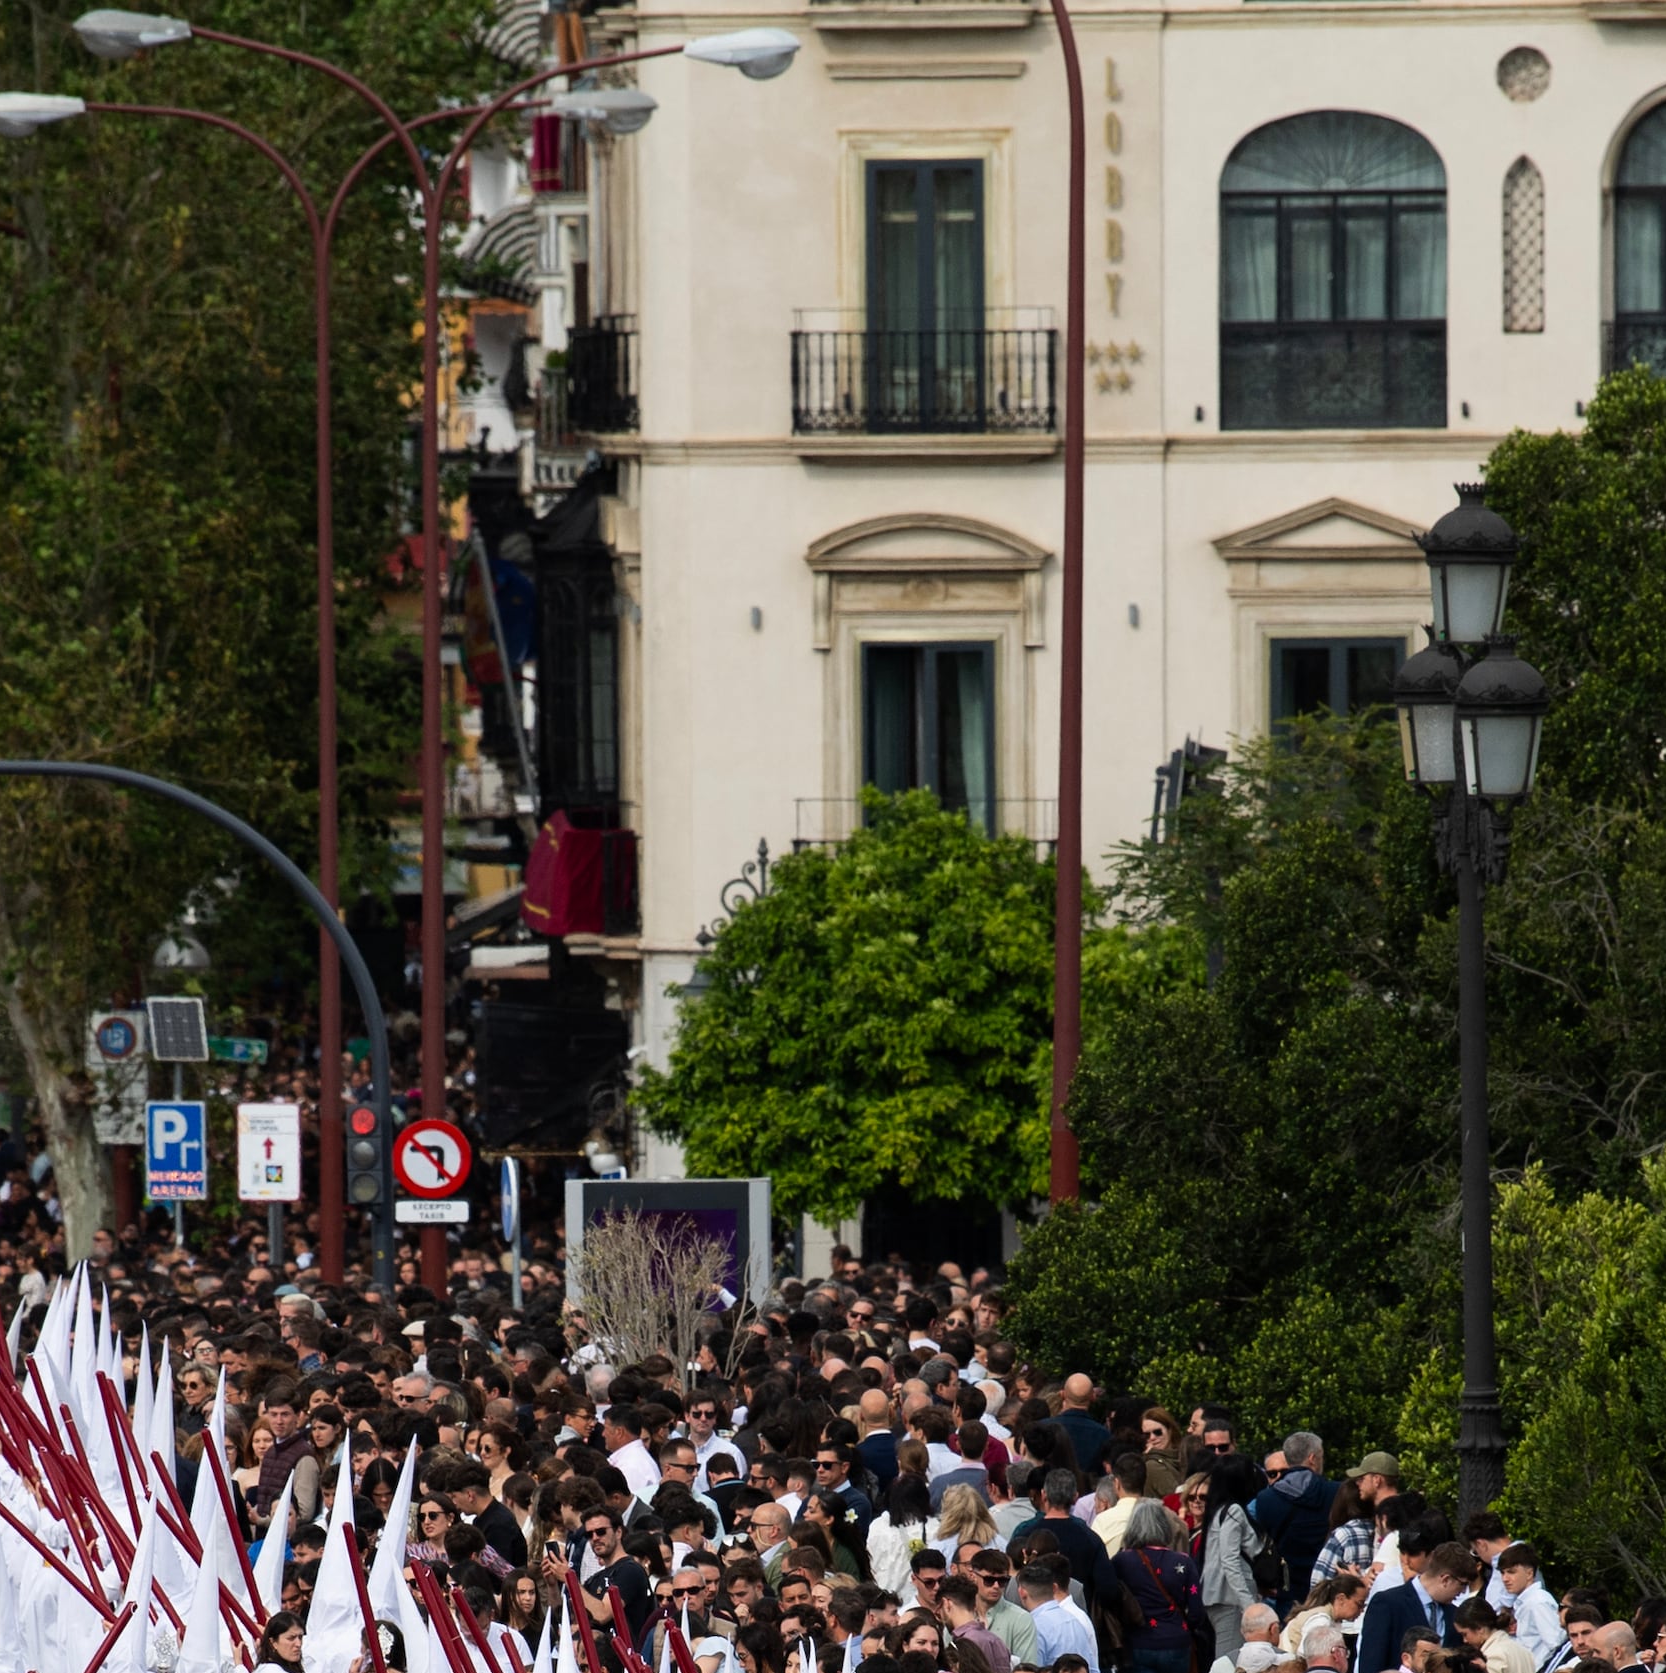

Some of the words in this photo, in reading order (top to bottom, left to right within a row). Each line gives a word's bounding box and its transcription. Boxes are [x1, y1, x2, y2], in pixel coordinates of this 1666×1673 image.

[1105, 56, 1123, 318] LOBBY
[153, 1109, 188, 1160] P
[151, 1185, 202, 1197] ARENAL
[413, 1203, 452, 1211] EXCEPTO
